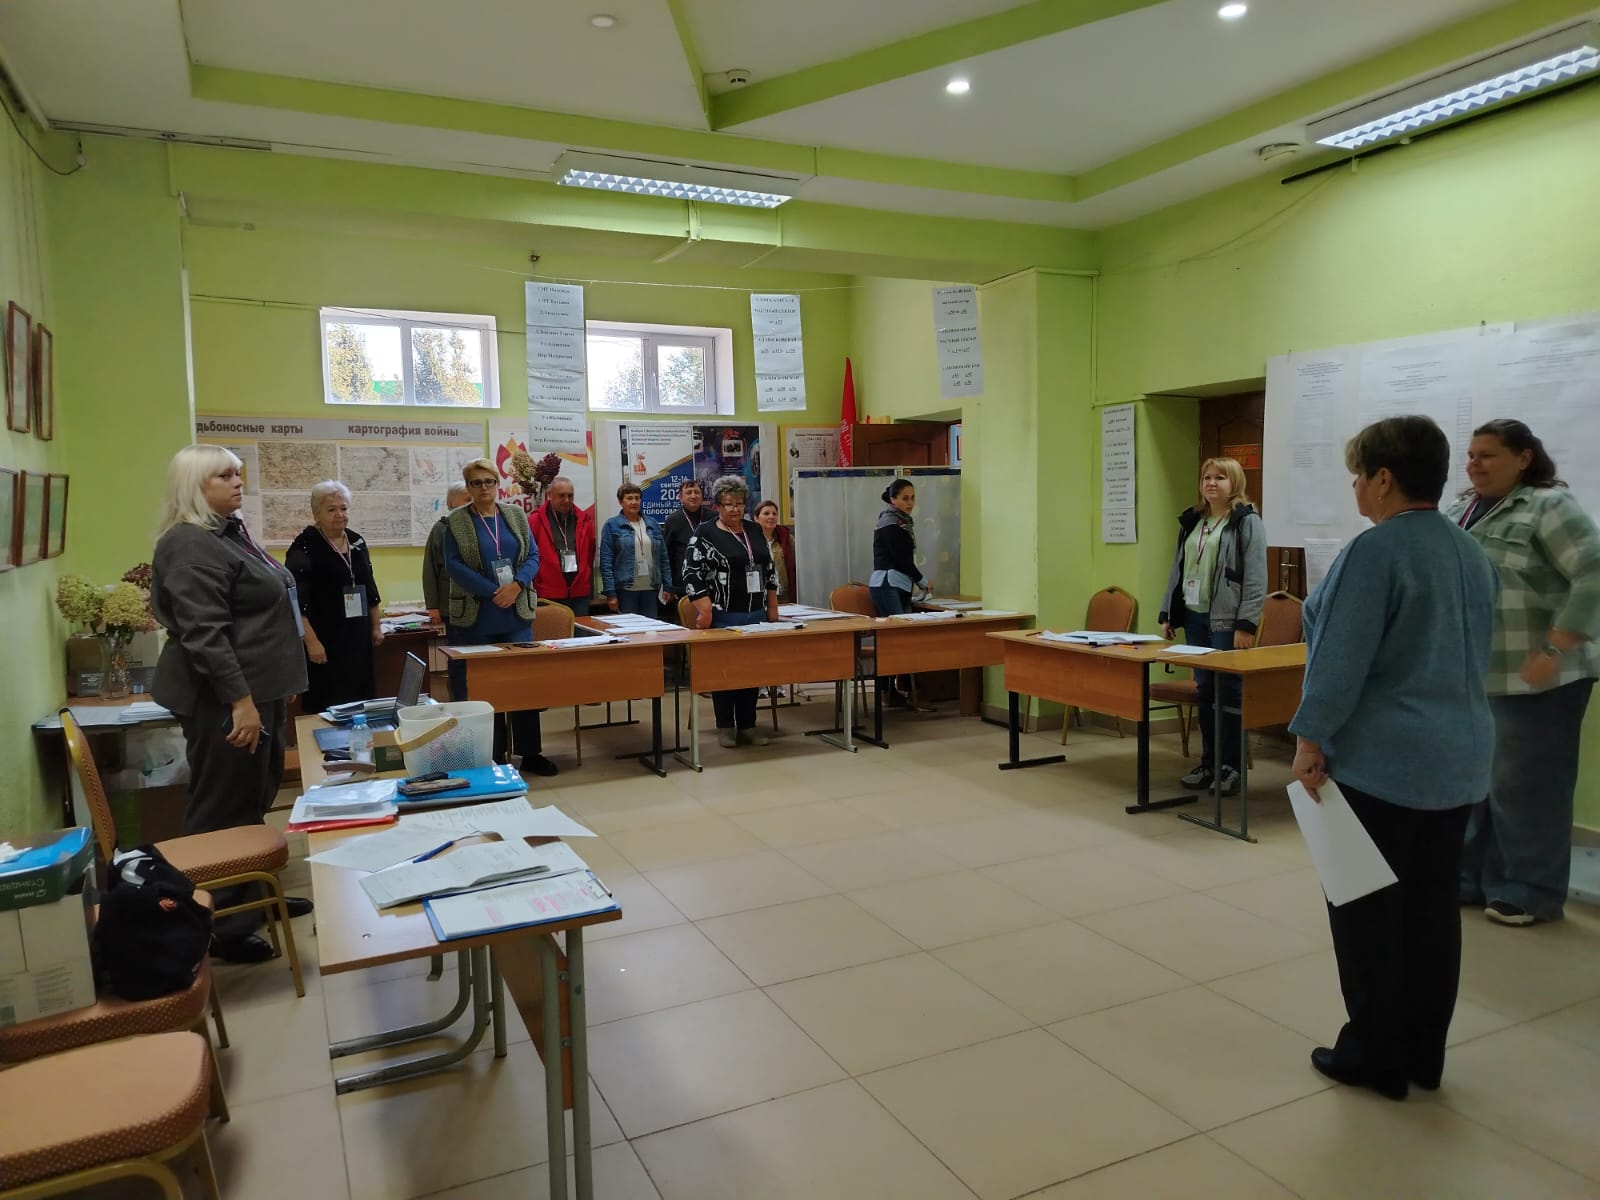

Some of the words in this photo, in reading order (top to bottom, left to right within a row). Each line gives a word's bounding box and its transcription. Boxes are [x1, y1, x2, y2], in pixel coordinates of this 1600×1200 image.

[195, 421, 265, 434] дьбоносные
[271, 424, 304, 436] карты
[348, 424, 421, 437] картография
[424, 425, 459, 437] войны
[660, 488, 681, 501] 202
